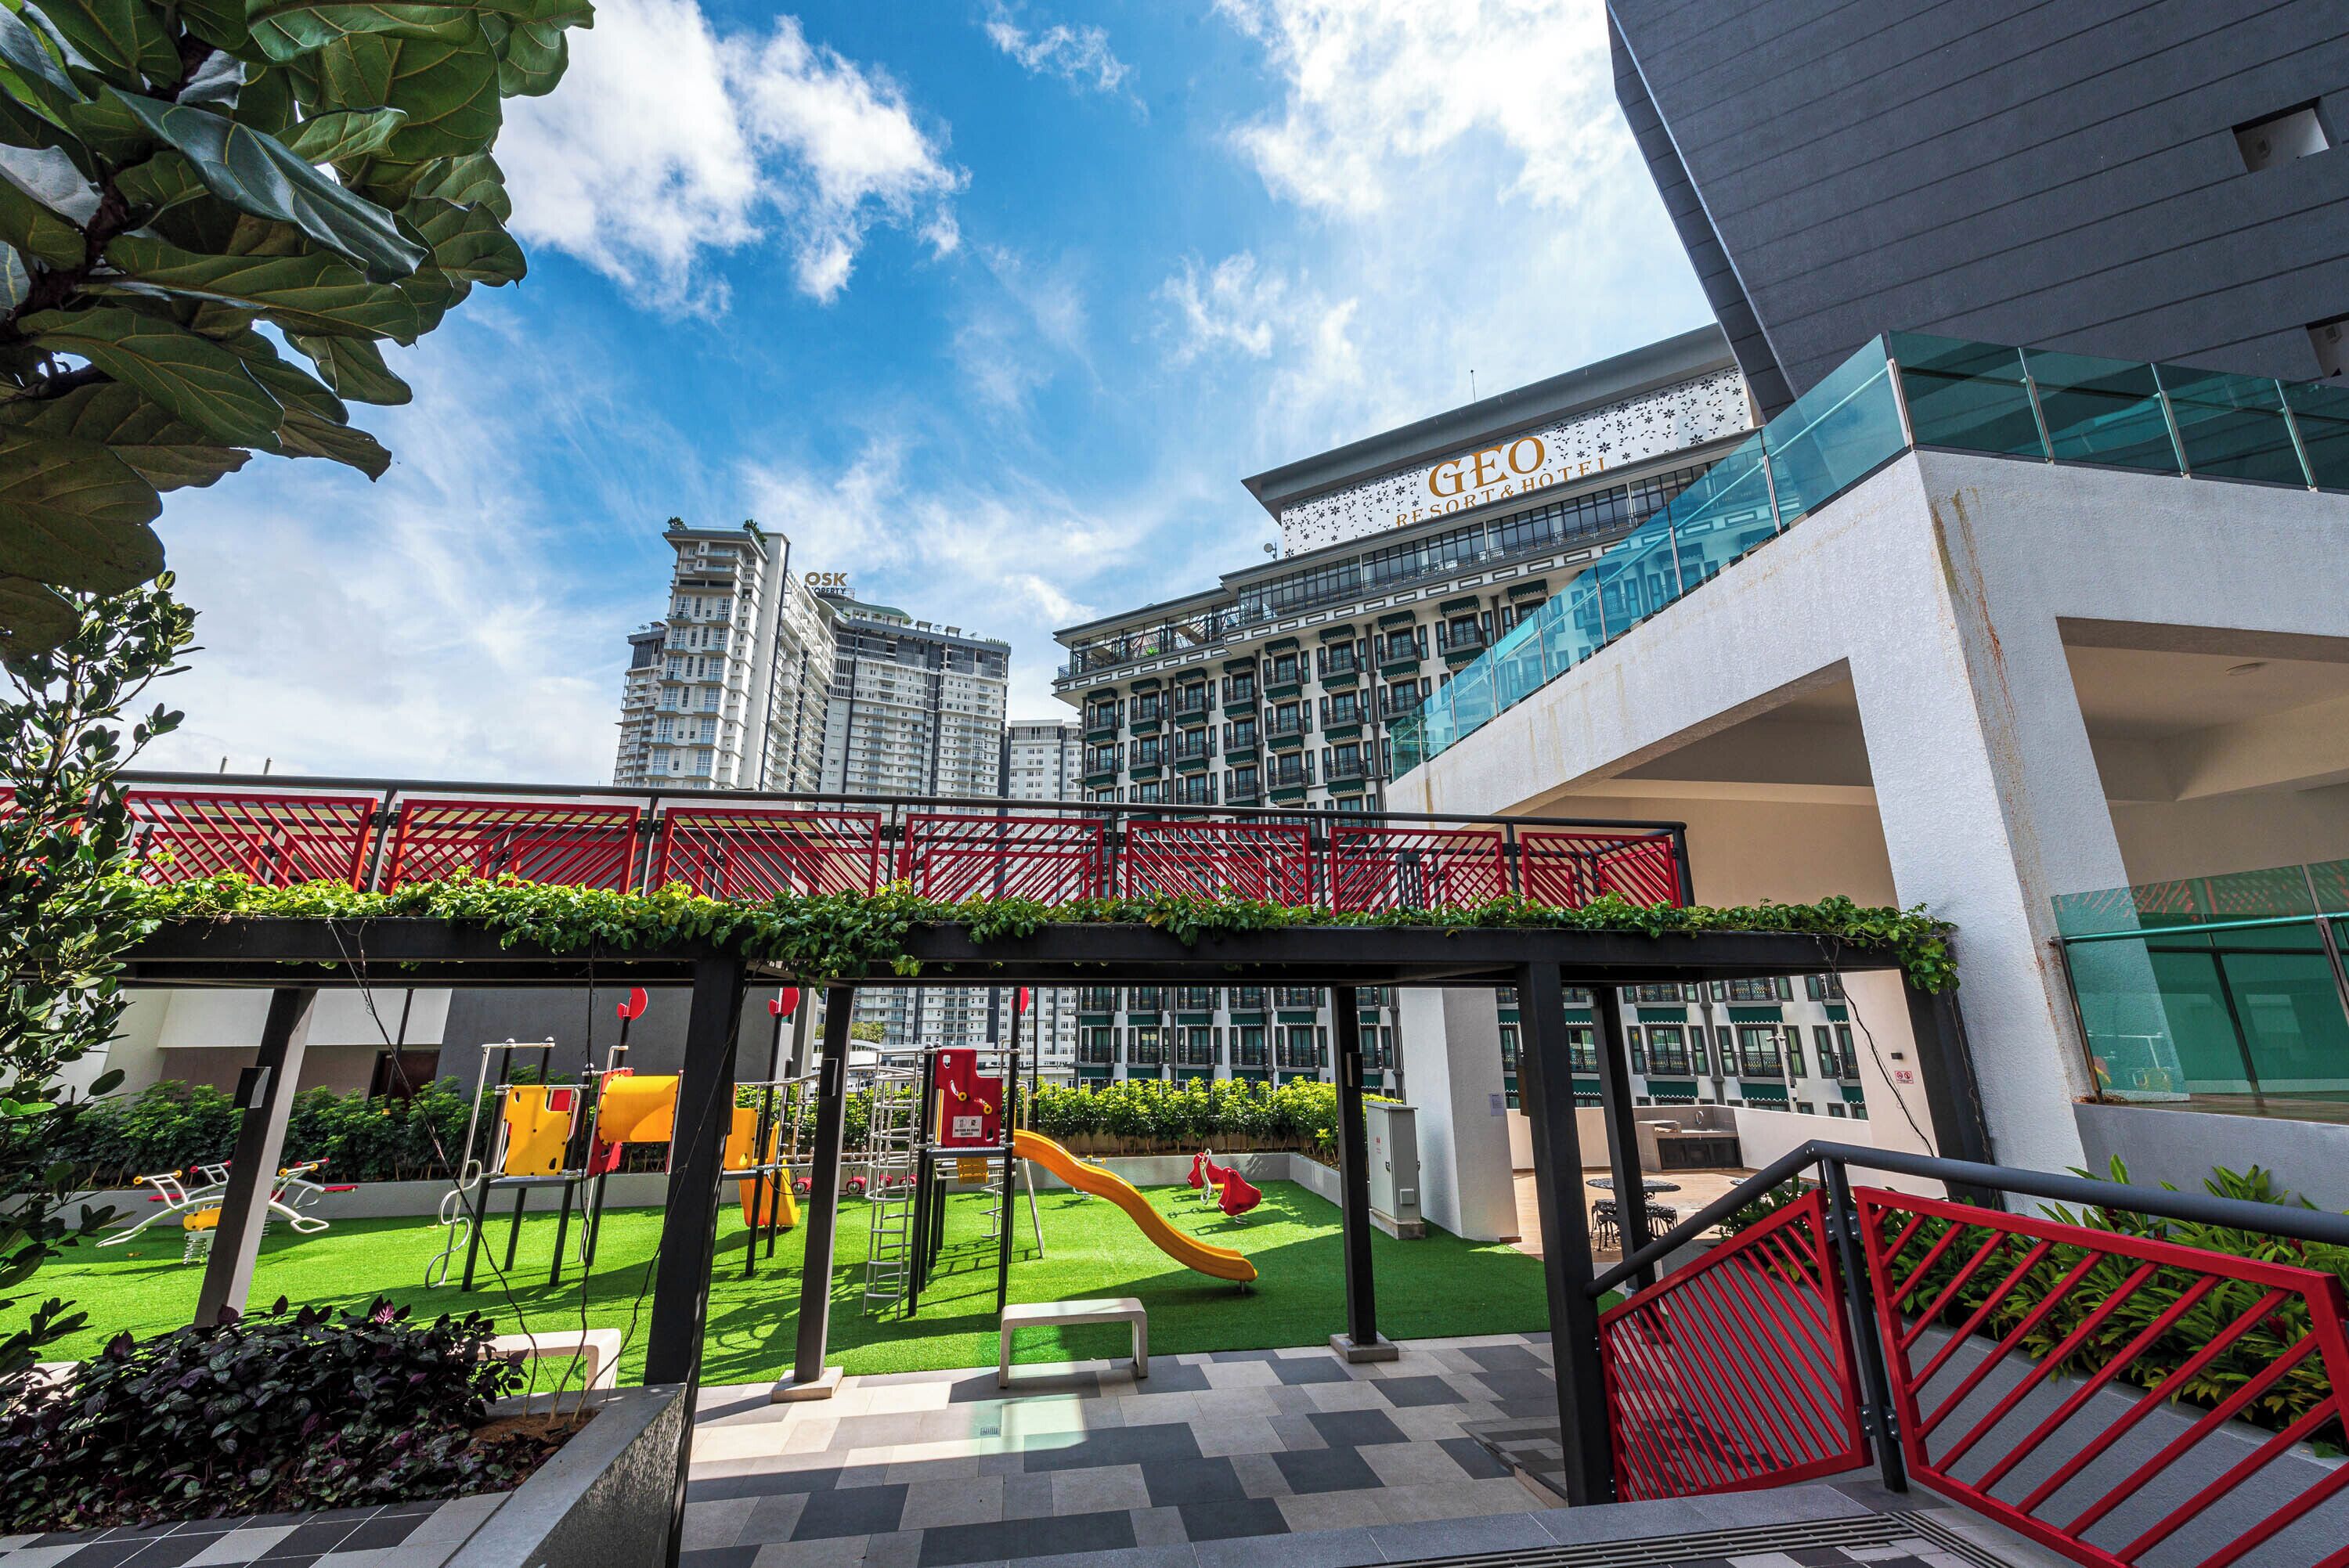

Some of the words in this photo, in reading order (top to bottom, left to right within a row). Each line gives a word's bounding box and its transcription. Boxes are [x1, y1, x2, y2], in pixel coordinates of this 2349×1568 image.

[1396, 488, 1495, 527] RESORT
[1521, 456, 1611, 492] HOTEL
[1428, 436, 1545, 498] GEO
[805, 571, 847, 586] OSK
